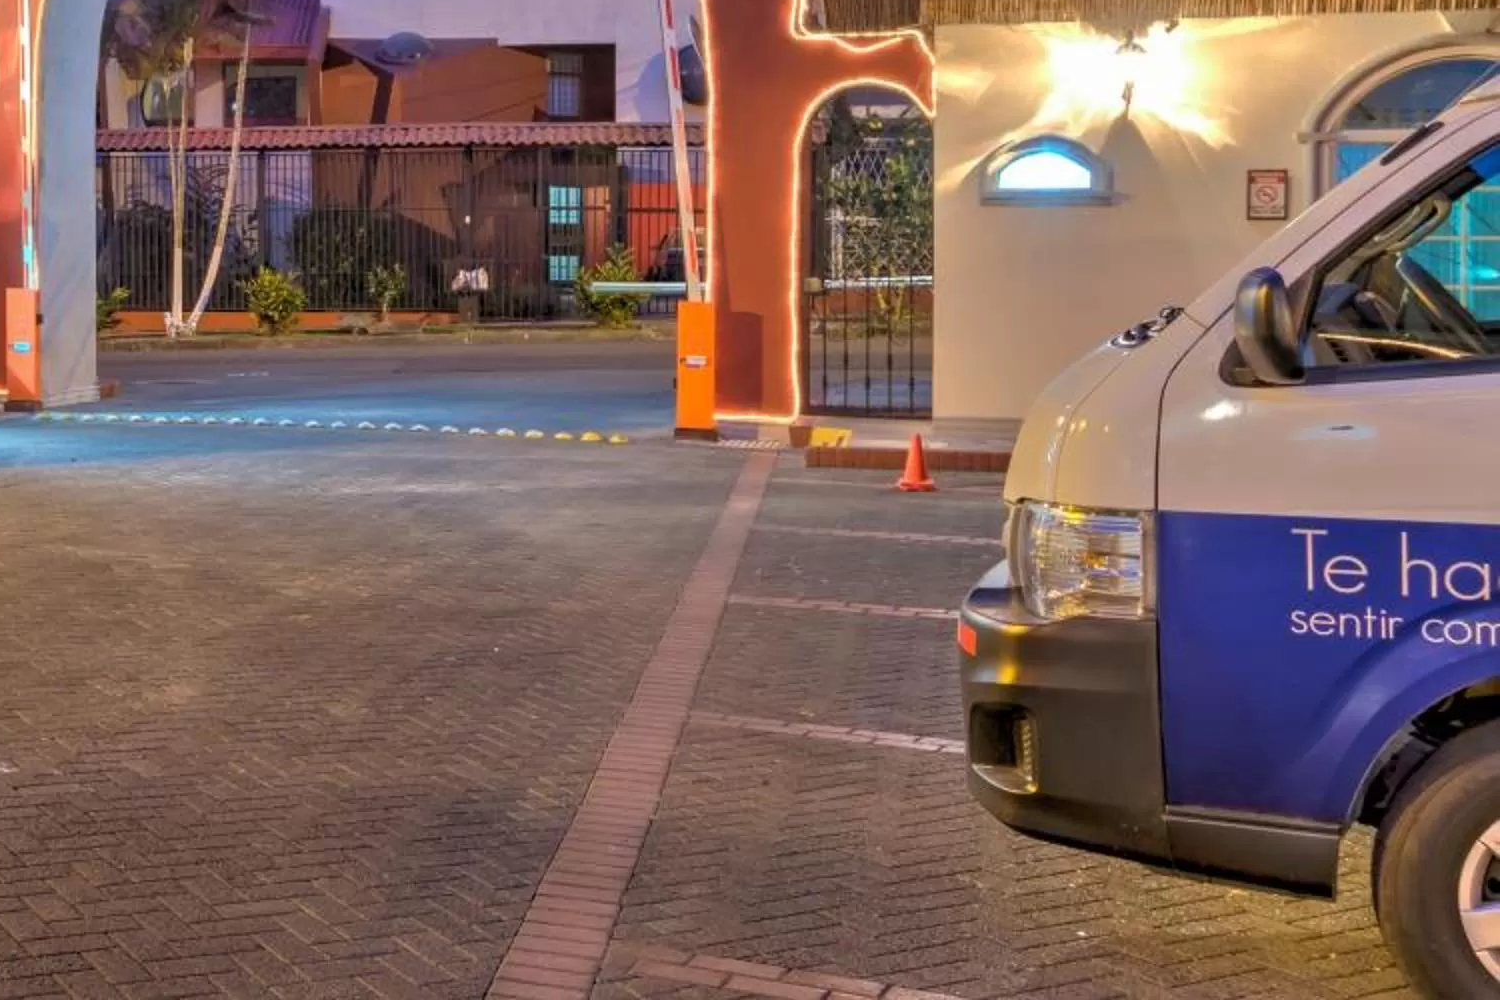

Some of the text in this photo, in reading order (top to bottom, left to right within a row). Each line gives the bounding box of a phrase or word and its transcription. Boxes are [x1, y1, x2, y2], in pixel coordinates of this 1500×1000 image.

[1291, 528, 1500, 601] Te ha
[1291, 607, 1403, 640] sentir
